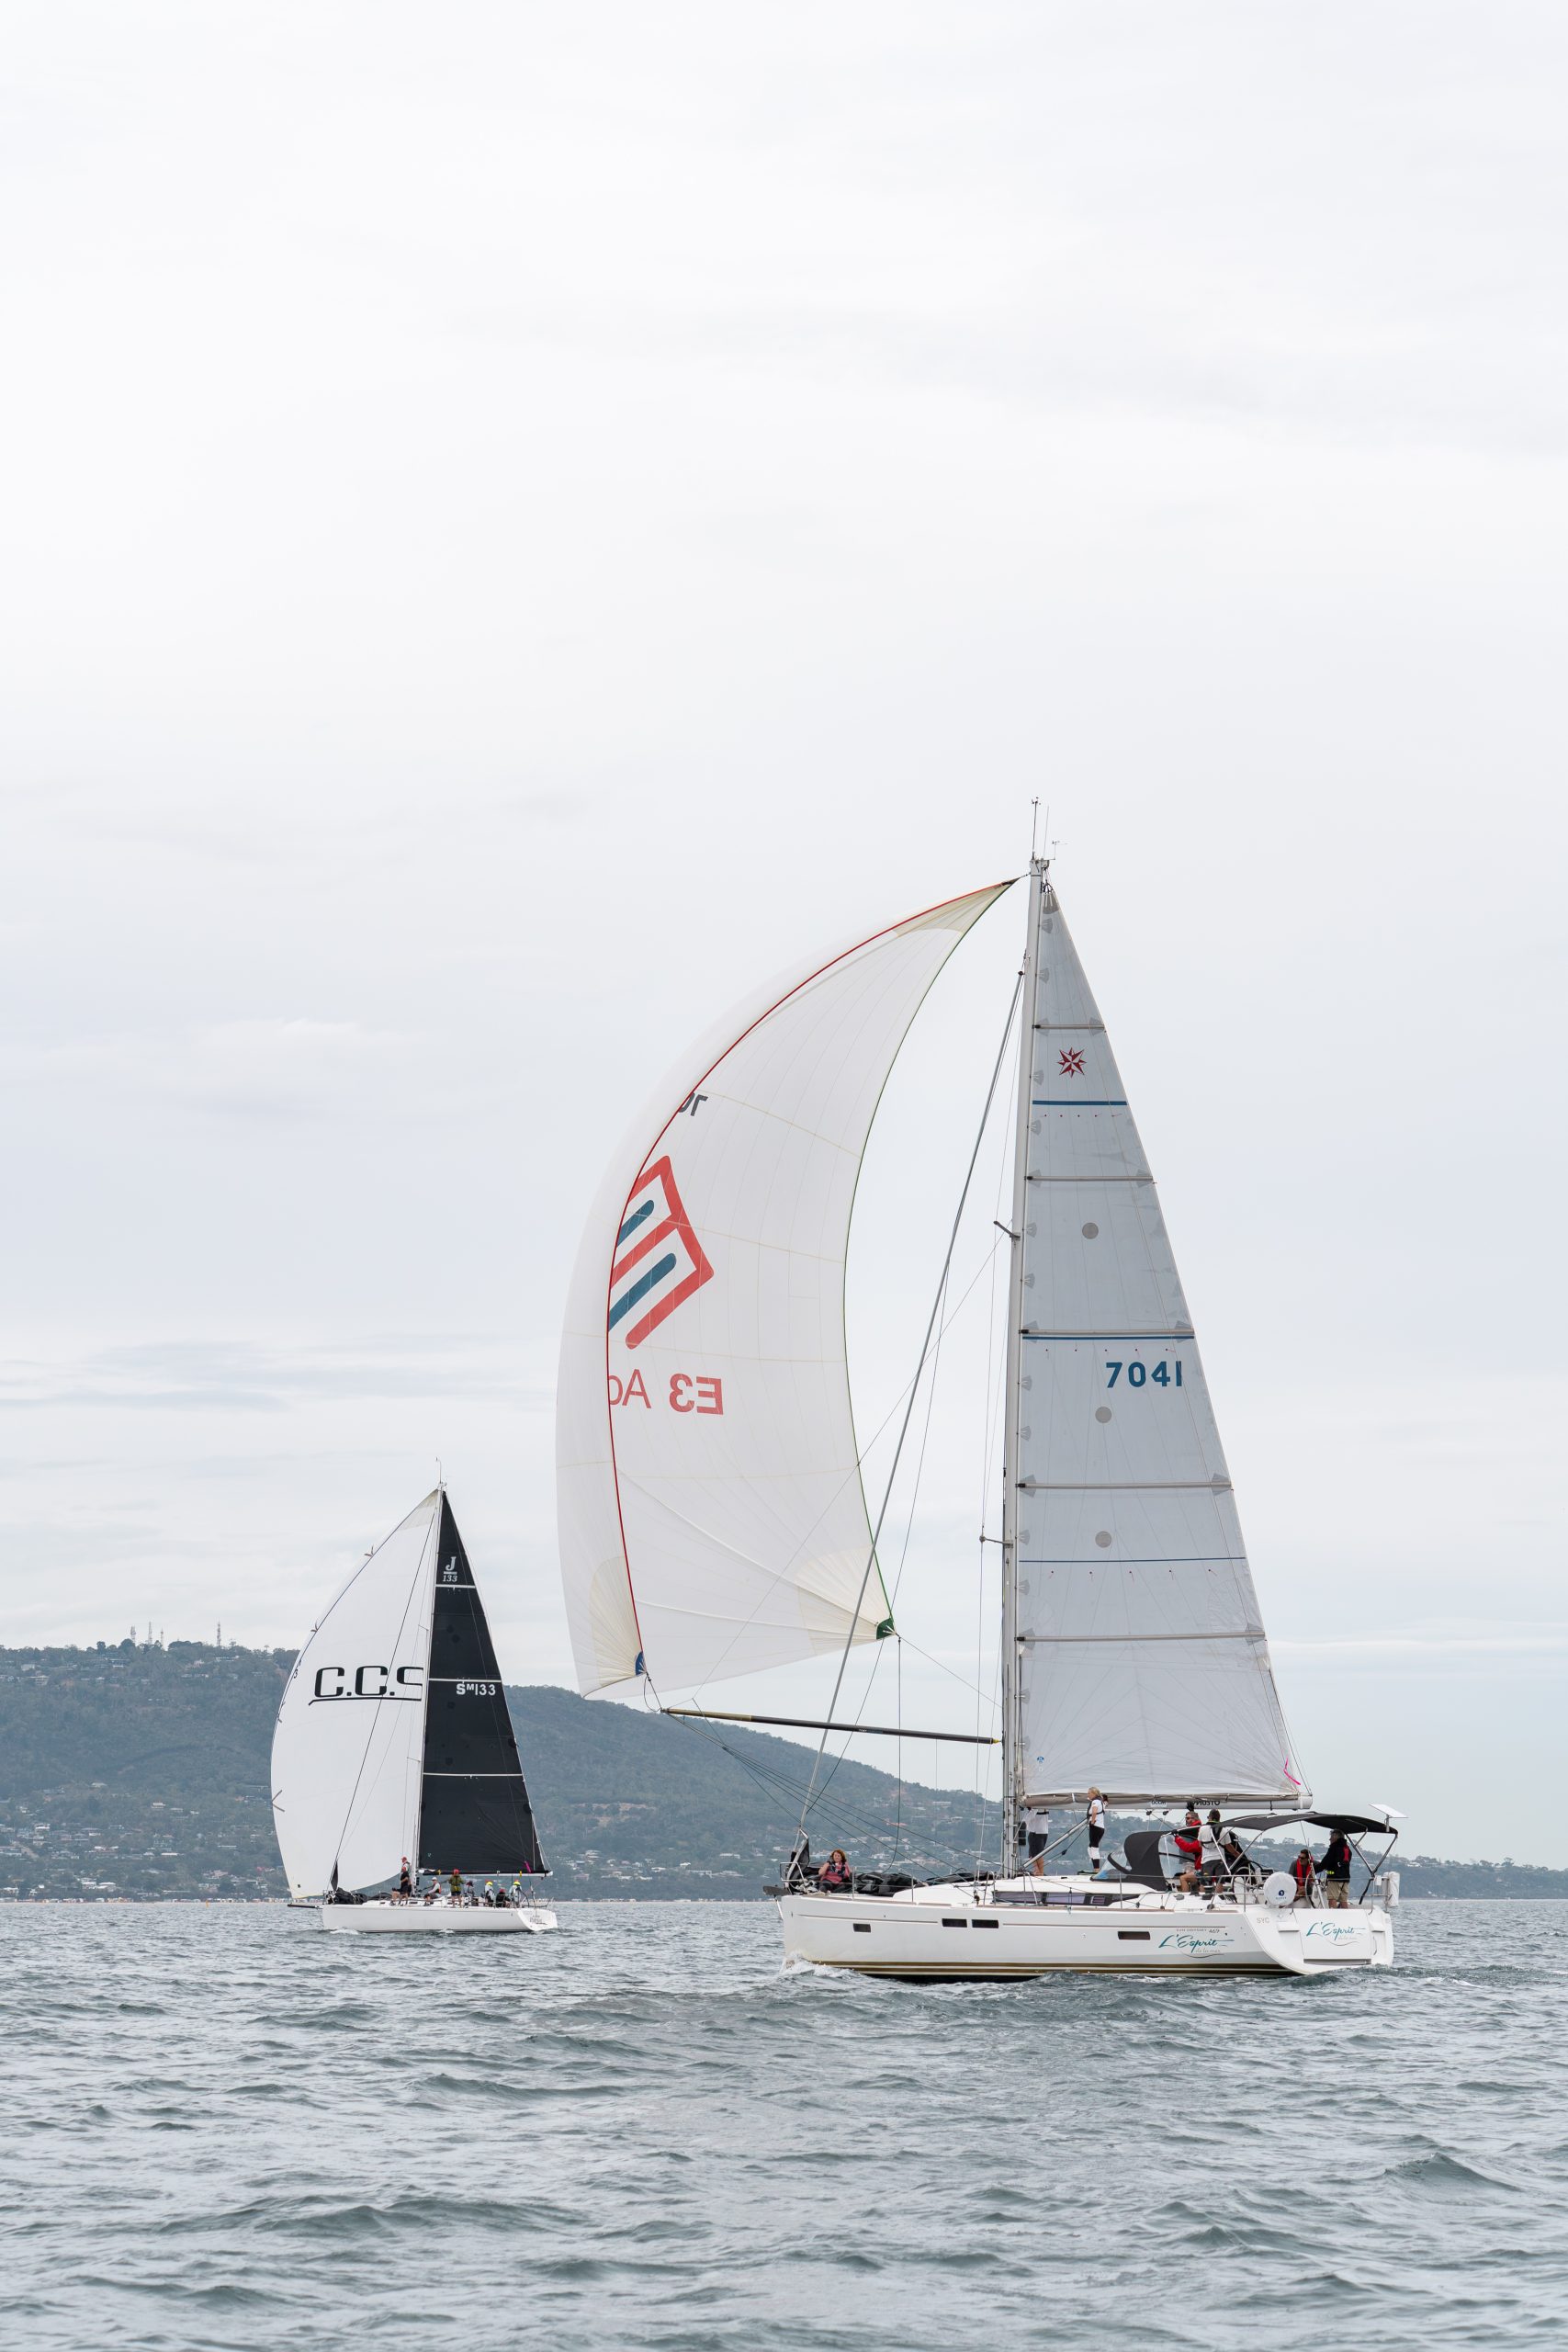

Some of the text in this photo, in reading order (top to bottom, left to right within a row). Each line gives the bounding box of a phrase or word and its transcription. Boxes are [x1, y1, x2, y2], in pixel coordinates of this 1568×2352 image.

[1106, 1361, 1182, 1388] 7041
[446, 1556, 457, 1571] J
[1306, 1921, 1366, 1941] L'Esprit
[1158, 1933, 1234, 1953] L'Esprit
